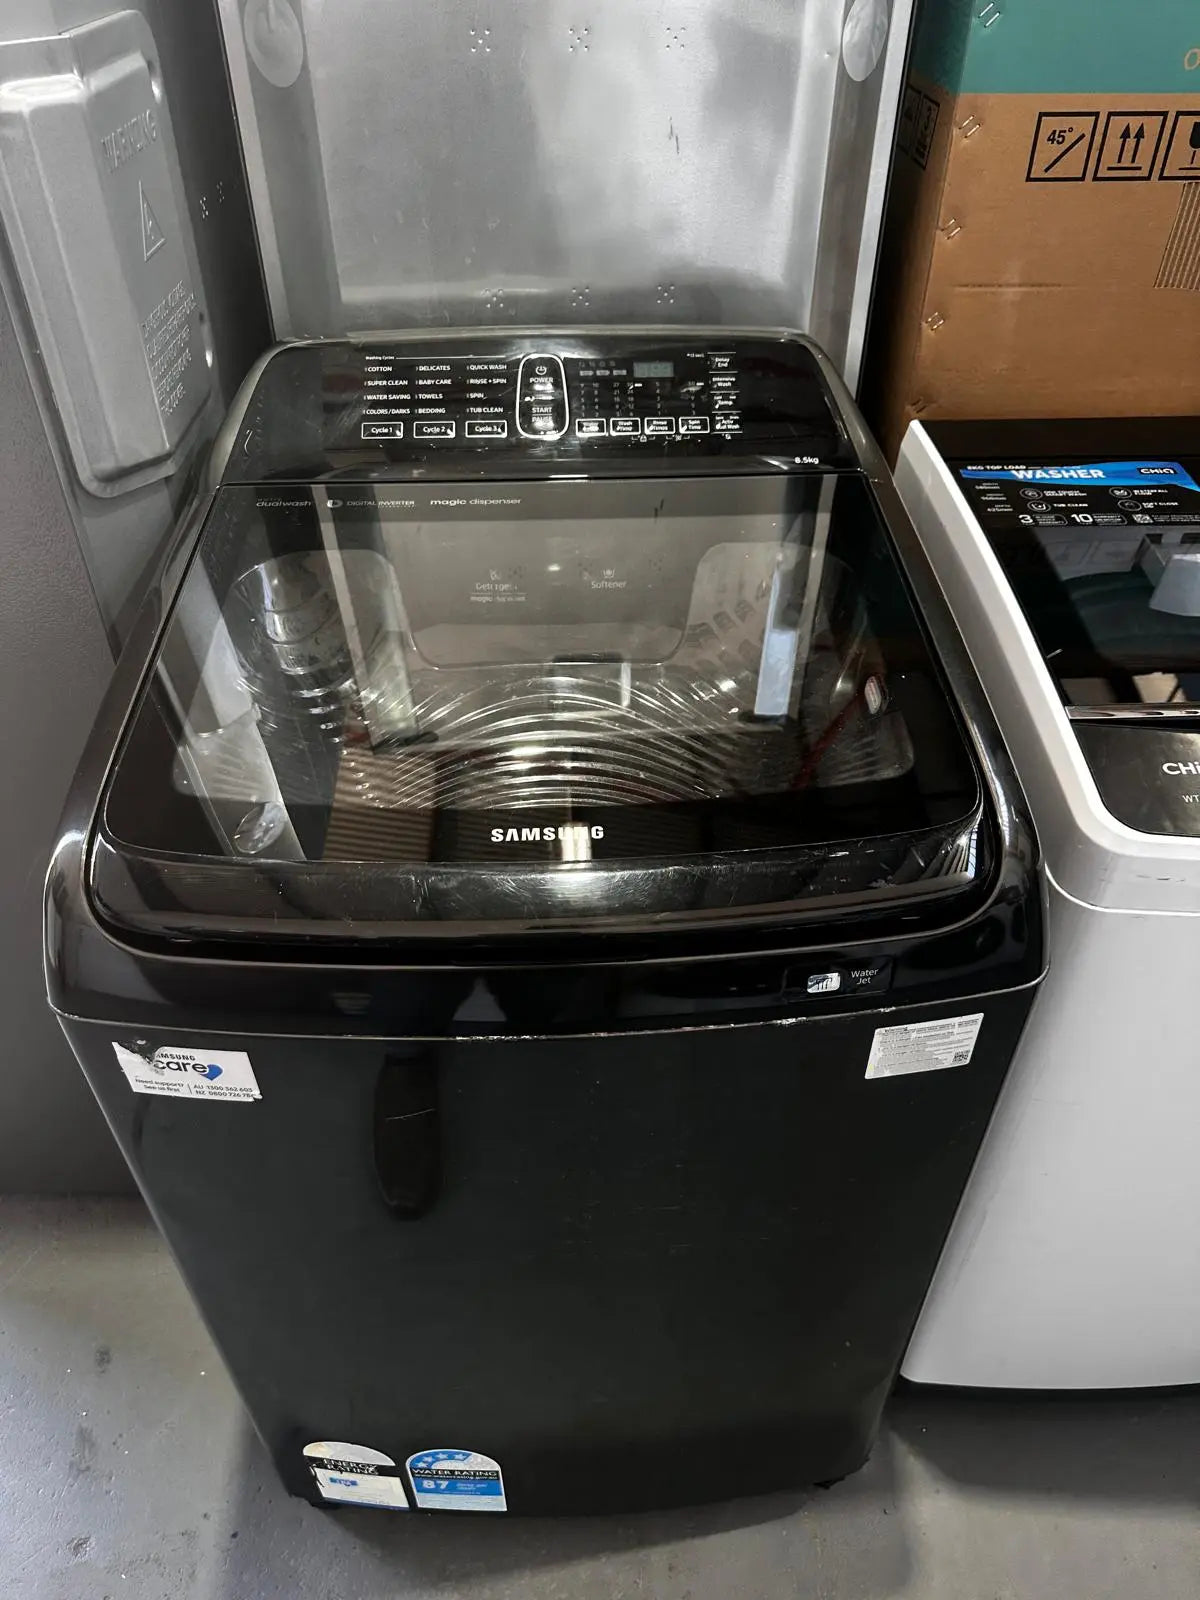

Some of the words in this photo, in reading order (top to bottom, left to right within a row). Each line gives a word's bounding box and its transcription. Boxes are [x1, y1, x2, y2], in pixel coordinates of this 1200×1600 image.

[423, 425, 440, 433] Cycle
[1011, 469, 1107, 479] WASHER
[1018, 514, 1034, 524] 3
[1070, 514, 1094, 523] 10
[591, 580, 627, 589] Softener
[851, 968, 879, 978] Water
[857, 976, 872, 985] Jet
[155, 1053, 196, 1061] AMSUNG
[153, 1060, 208, 1072] care
[323, 1459, 378, 1470] ENERGY
[422, 1480, 449, 1489] 87
